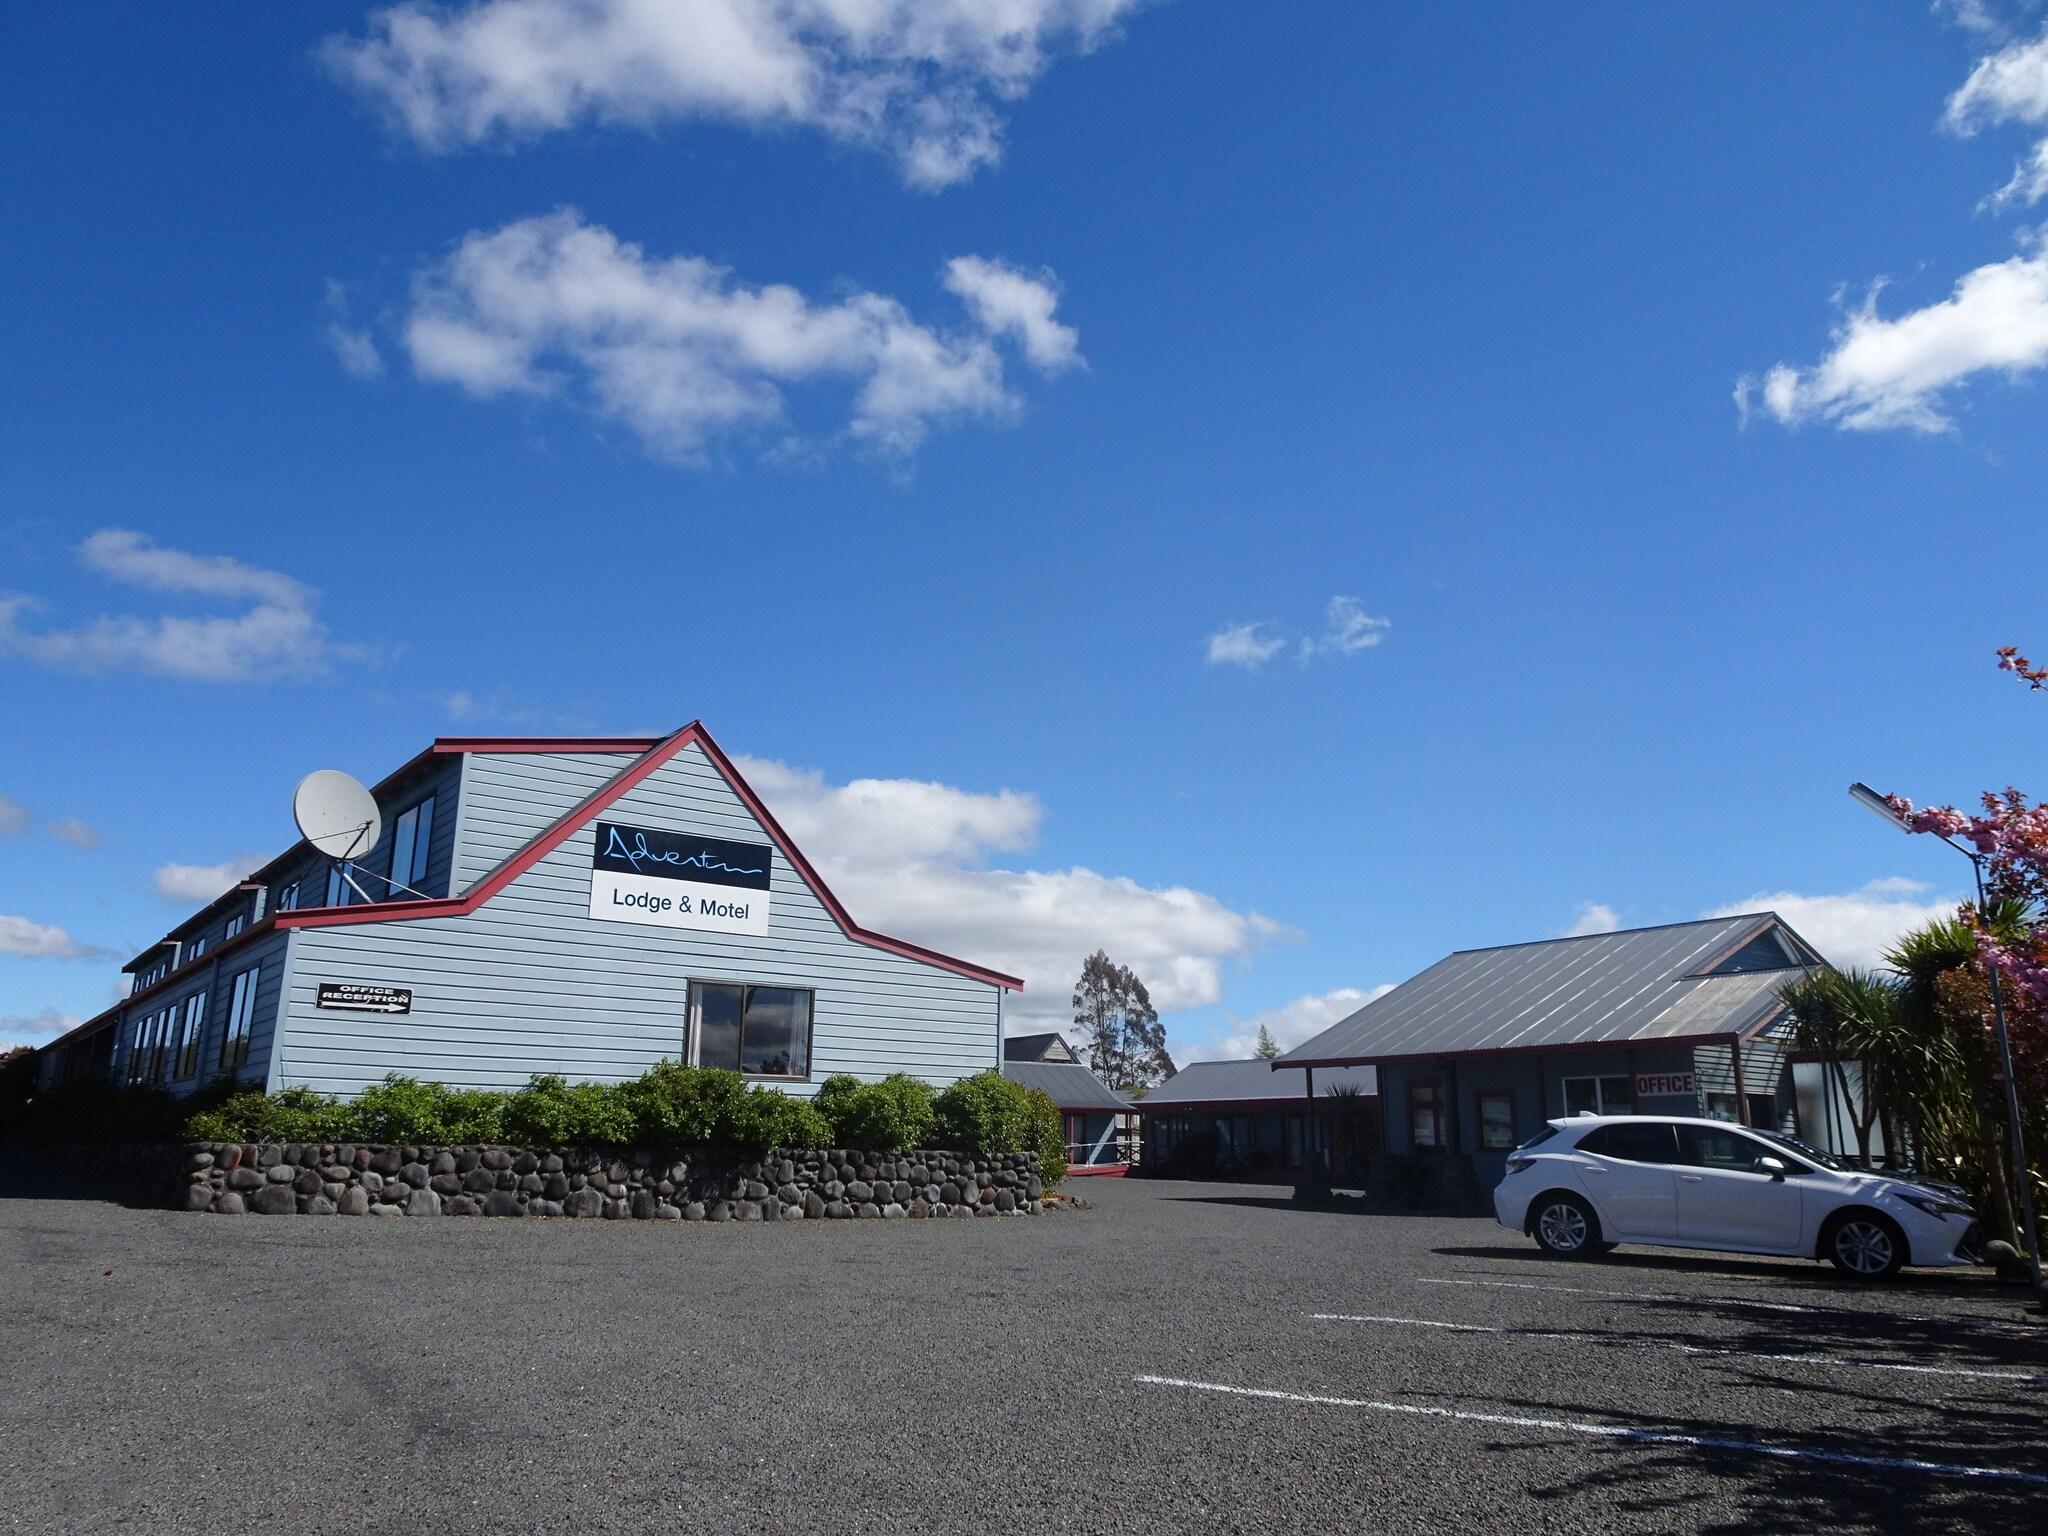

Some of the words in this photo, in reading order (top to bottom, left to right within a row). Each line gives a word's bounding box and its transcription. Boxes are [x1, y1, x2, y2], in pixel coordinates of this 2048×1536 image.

[613, 888, 672, 913] Lodge
[679, 895, 693, 914] &
[700, 899, 749, 920] Motel
[339, 985, 394, 995] OFFICE
[322, 992, 409, 1003] RECEPTION
[1639, 1075, 1693, 1093] OFFICE
